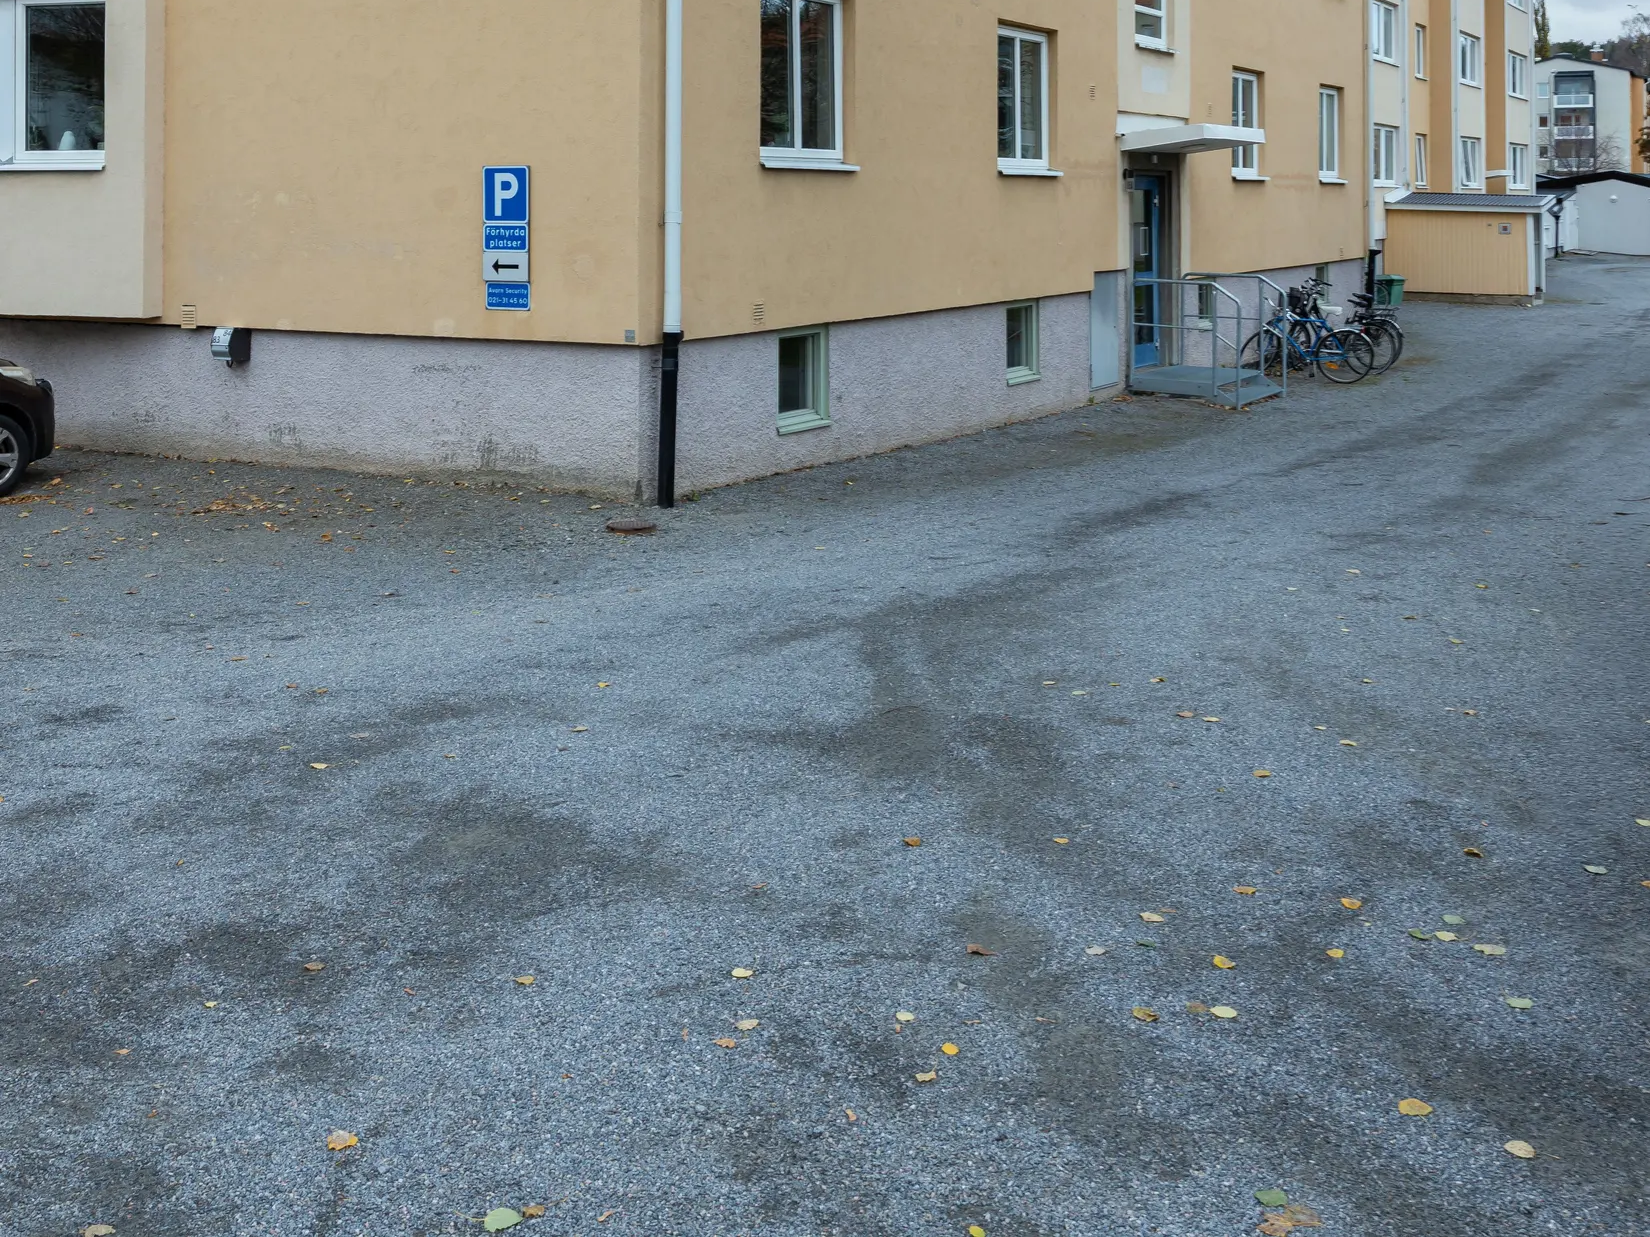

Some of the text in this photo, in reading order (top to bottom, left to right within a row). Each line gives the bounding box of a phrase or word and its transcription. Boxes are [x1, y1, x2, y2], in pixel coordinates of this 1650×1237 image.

[494, 172, 519, 217] P
[486, 228, 525, 237] Förhyrda
[490, 239, 521, 248] platser
[505, 287, 527, 295] Security
